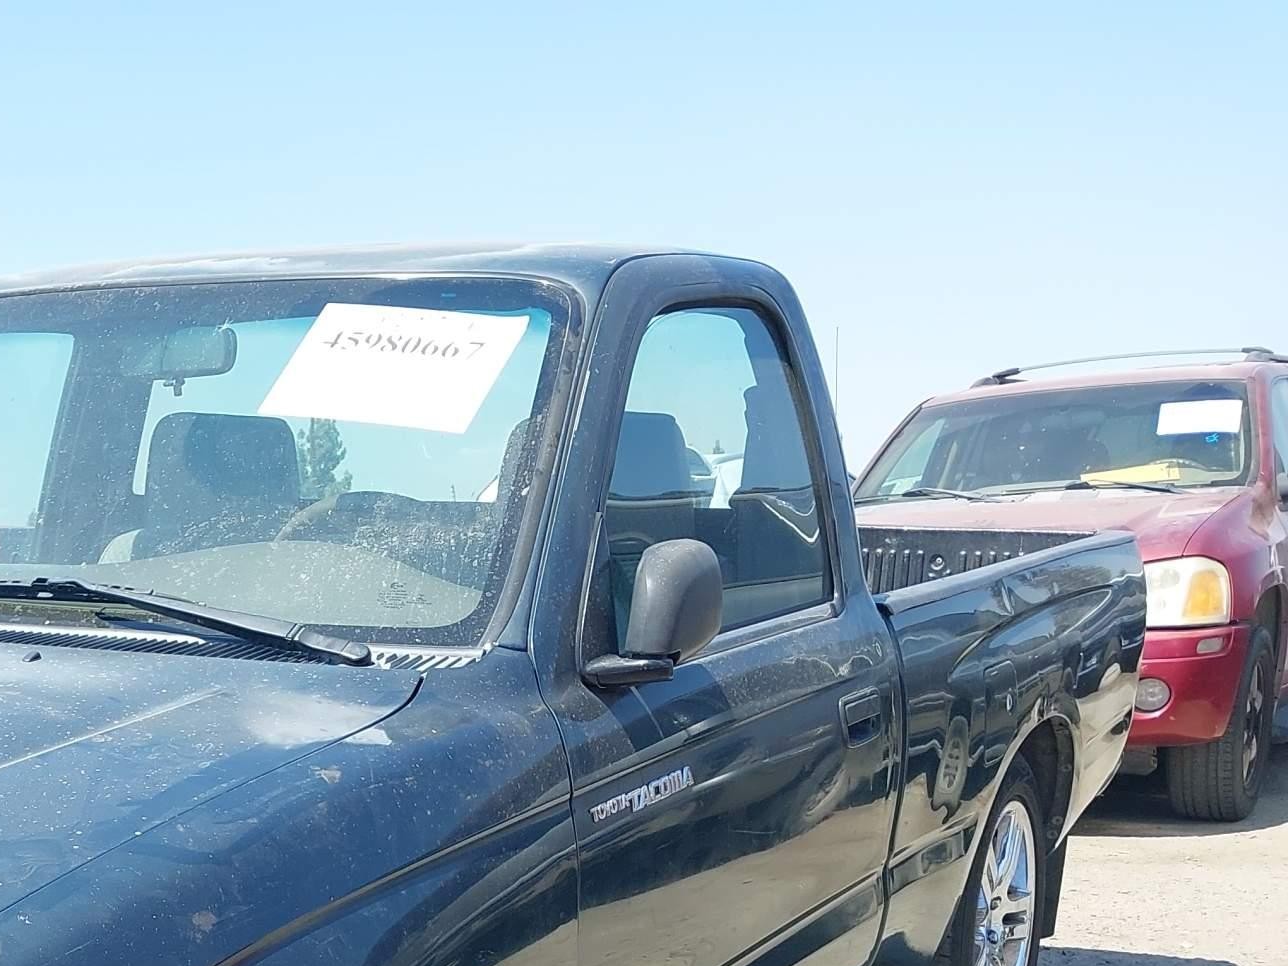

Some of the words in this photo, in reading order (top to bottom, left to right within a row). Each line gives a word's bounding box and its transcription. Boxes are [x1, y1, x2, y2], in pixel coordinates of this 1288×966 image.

[323, 330, 486, 360] 45980667
[589, 793, 630, 822] TOYOTA
[629, 766, 694, 812] TACOMA
